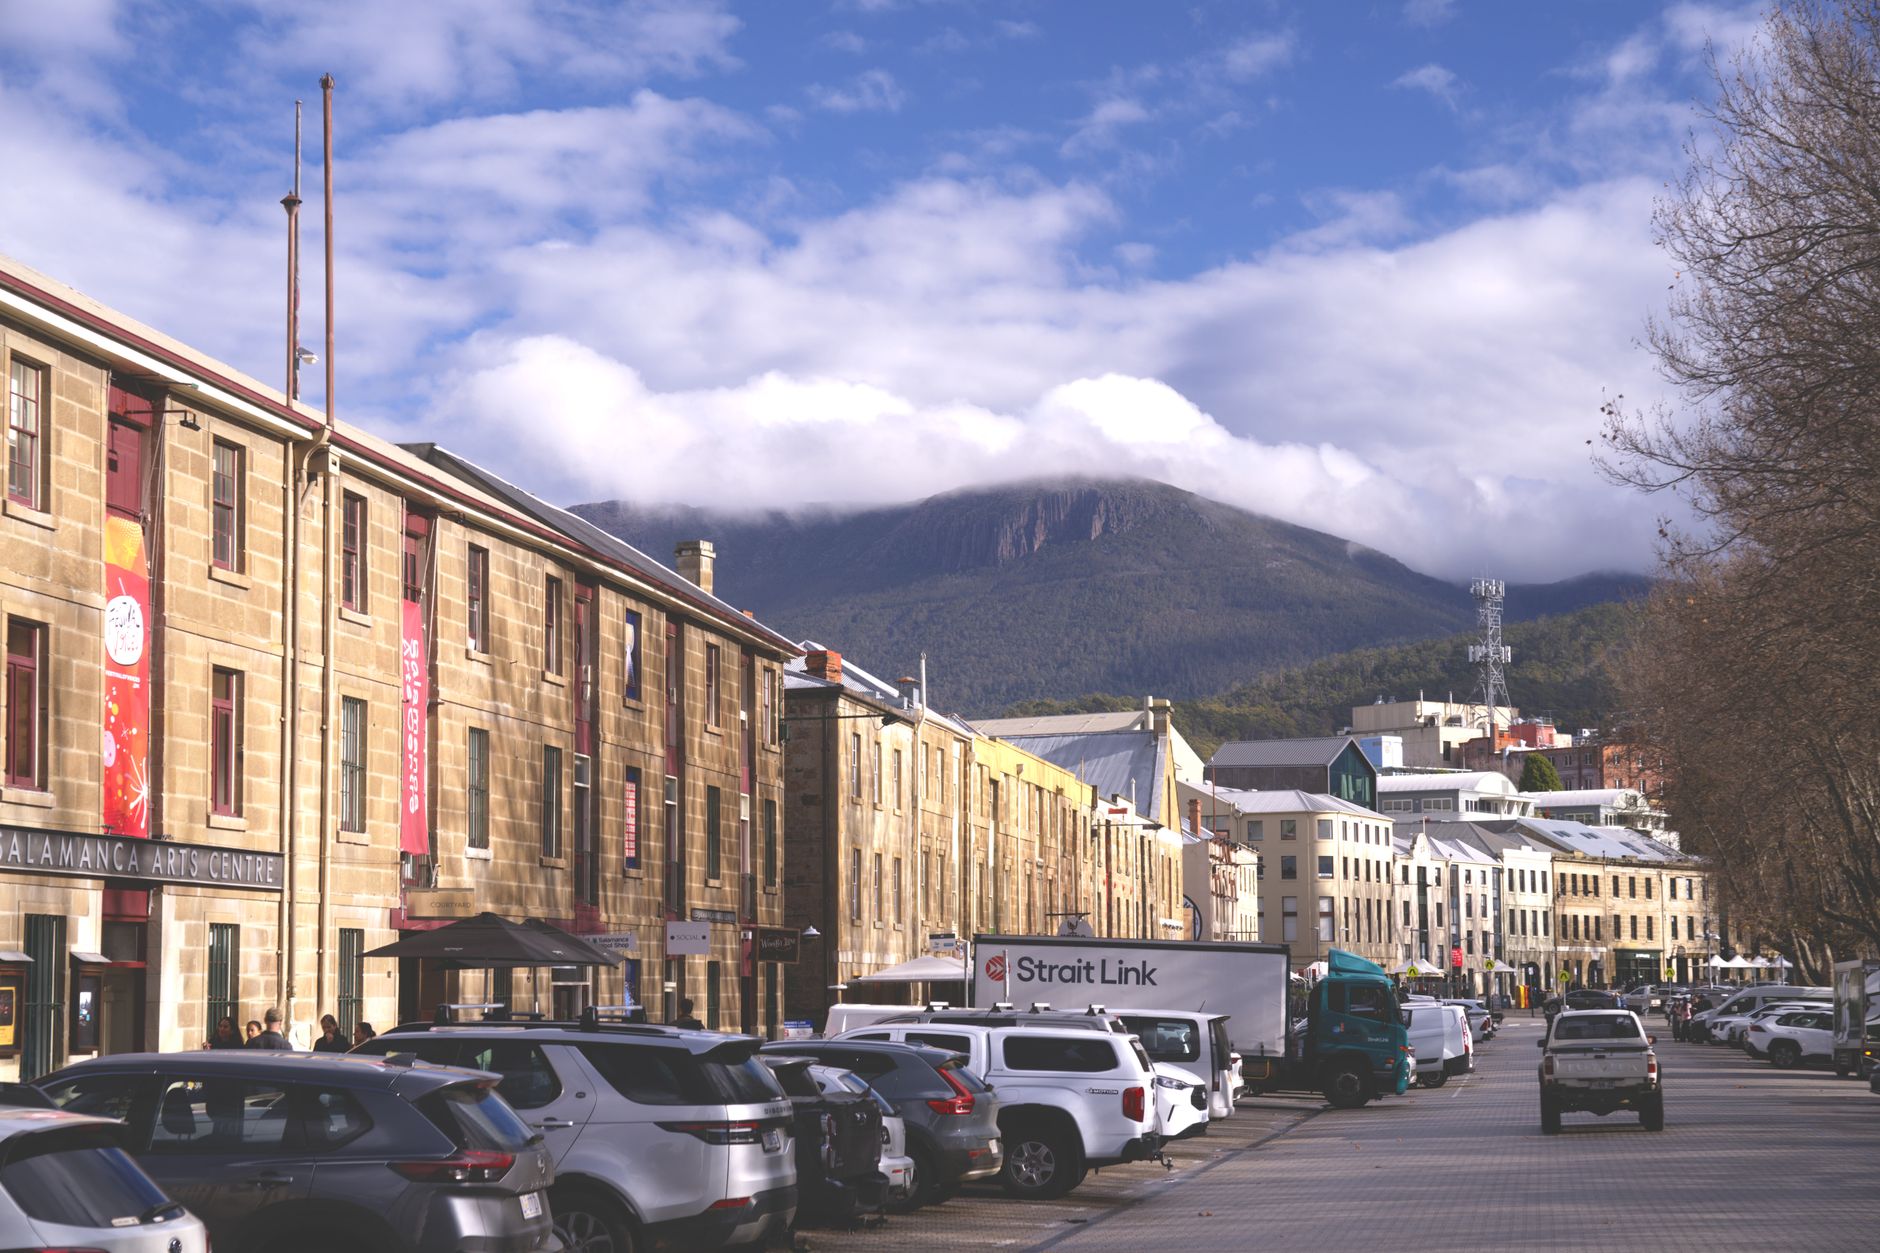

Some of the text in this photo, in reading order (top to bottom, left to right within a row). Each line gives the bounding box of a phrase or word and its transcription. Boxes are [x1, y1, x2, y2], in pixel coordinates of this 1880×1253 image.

[411, 640, 421, 811] Salamanca
[151, 847, 198, 877] ARTS
[208, 851, 273, 882] CENTRE
[1016, 956, 1158, 986] Strait Link
